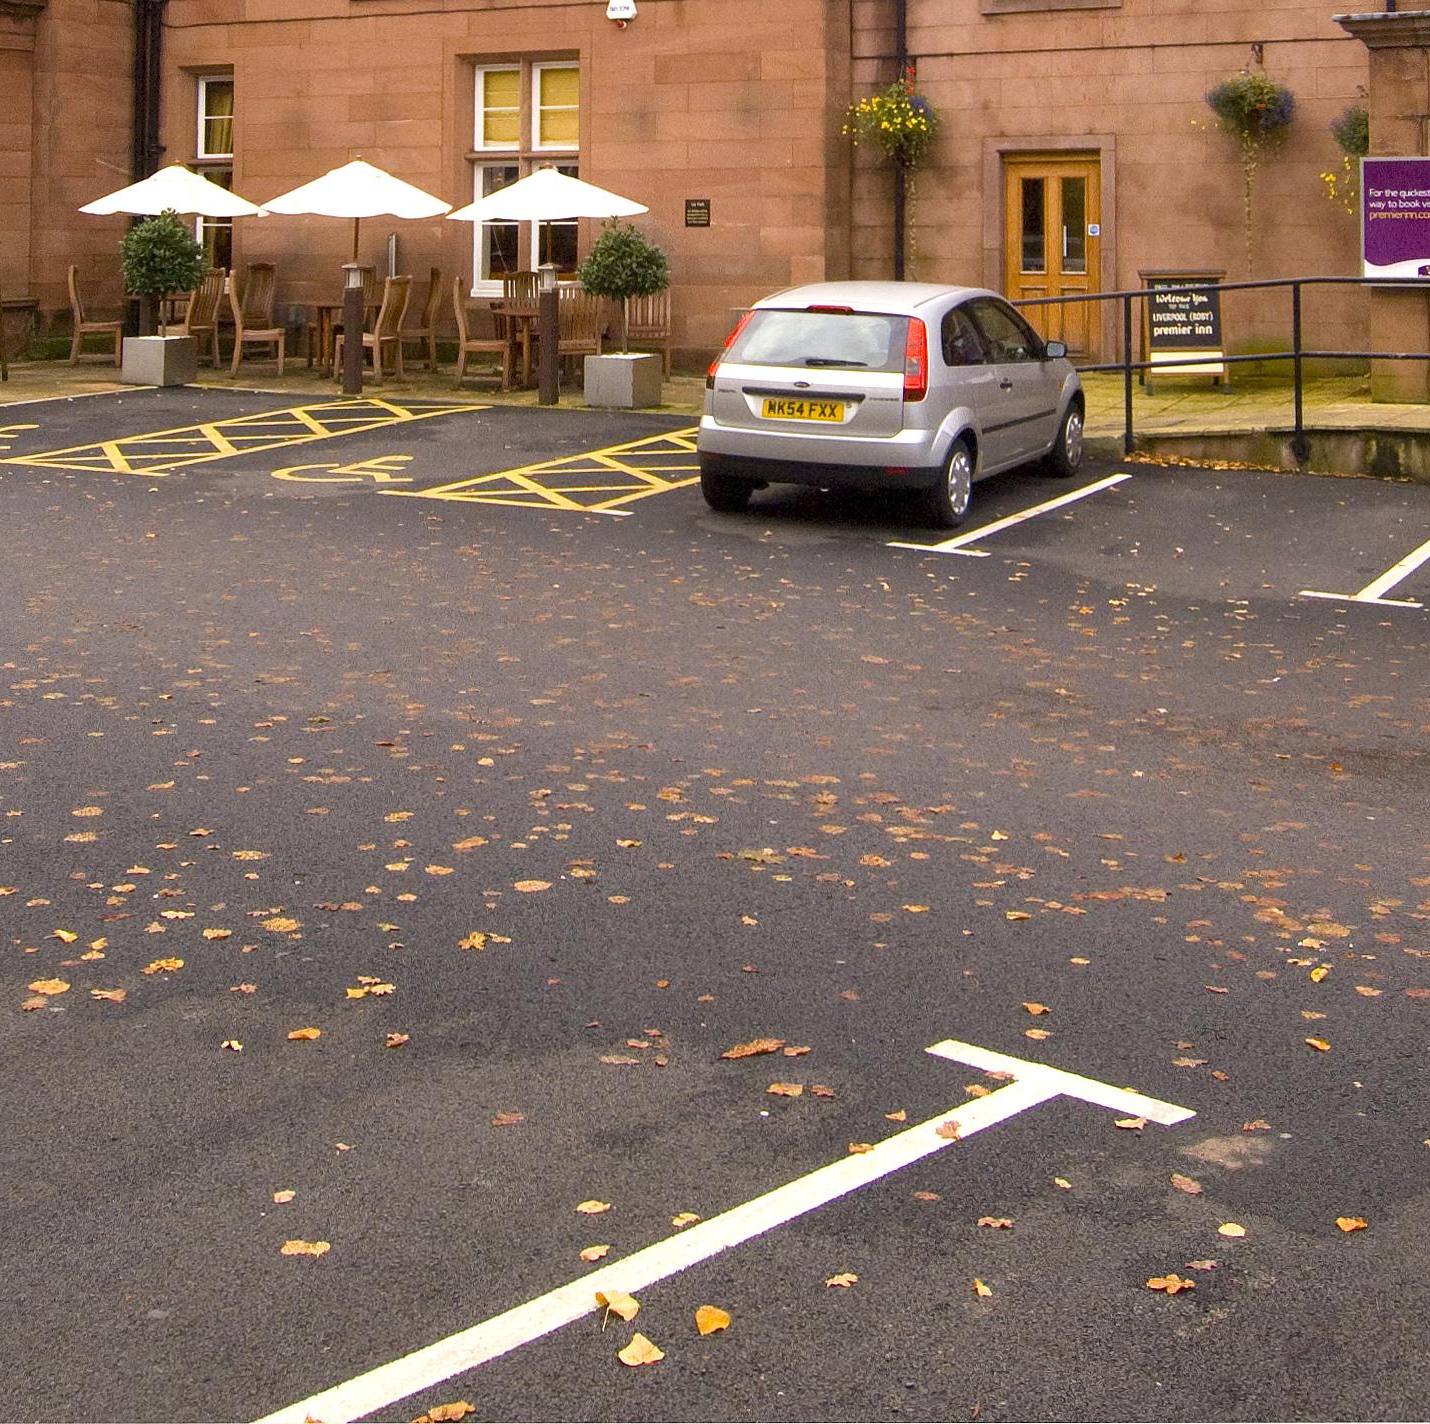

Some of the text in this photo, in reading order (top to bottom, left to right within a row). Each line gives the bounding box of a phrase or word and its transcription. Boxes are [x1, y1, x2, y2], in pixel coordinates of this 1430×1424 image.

[1369, 188, 1430, 199] For the quickest
[1369, 201, 1386, 210] way
[1388, 200, 1398, 208] to
[1399, 200, 1421, 208] book
[1153, 323, 1213, 337] premier inn
[809, 402, 837, 418] FXX
